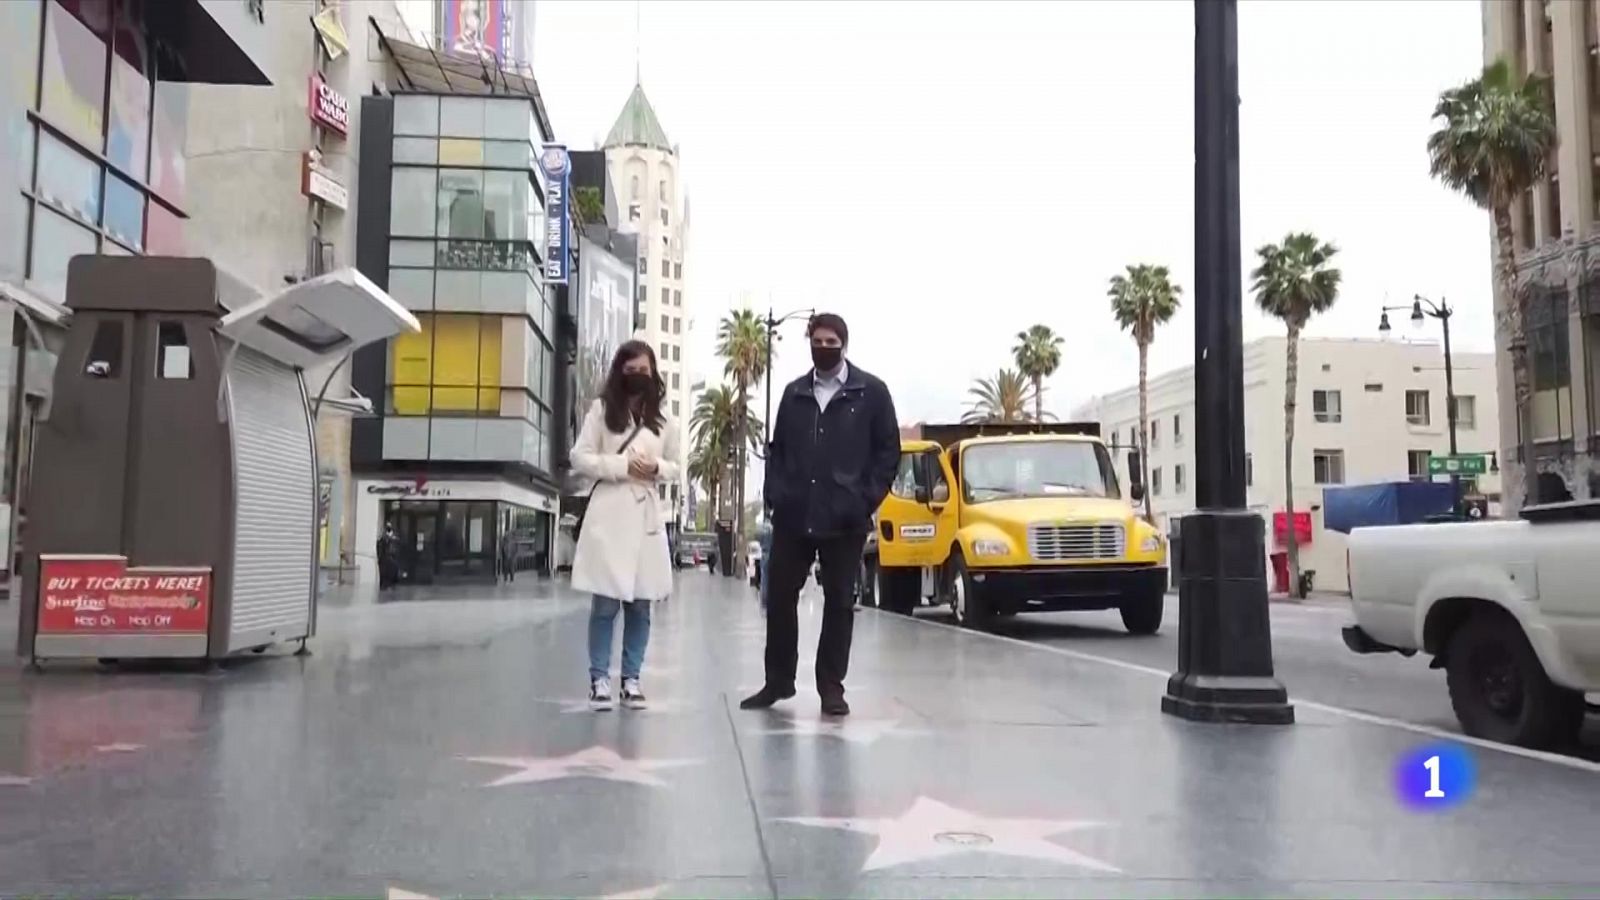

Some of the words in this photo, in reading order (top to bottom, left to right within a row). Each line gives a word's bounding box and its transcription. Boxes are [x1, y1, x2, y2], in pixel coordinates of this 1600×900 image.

[319, 96, 349, 125] WABO
[320, 84, 350, 113] CABO
[548, 180, 561, 205] PLAY
[548, 217, 561, 247] DRINK
[548, 259, 561, 277] EAT
[47, 577, 82, 590] BUY
[86, 577, 151, 590] TICKETS
[154, 576, 203, 591] HERE!
